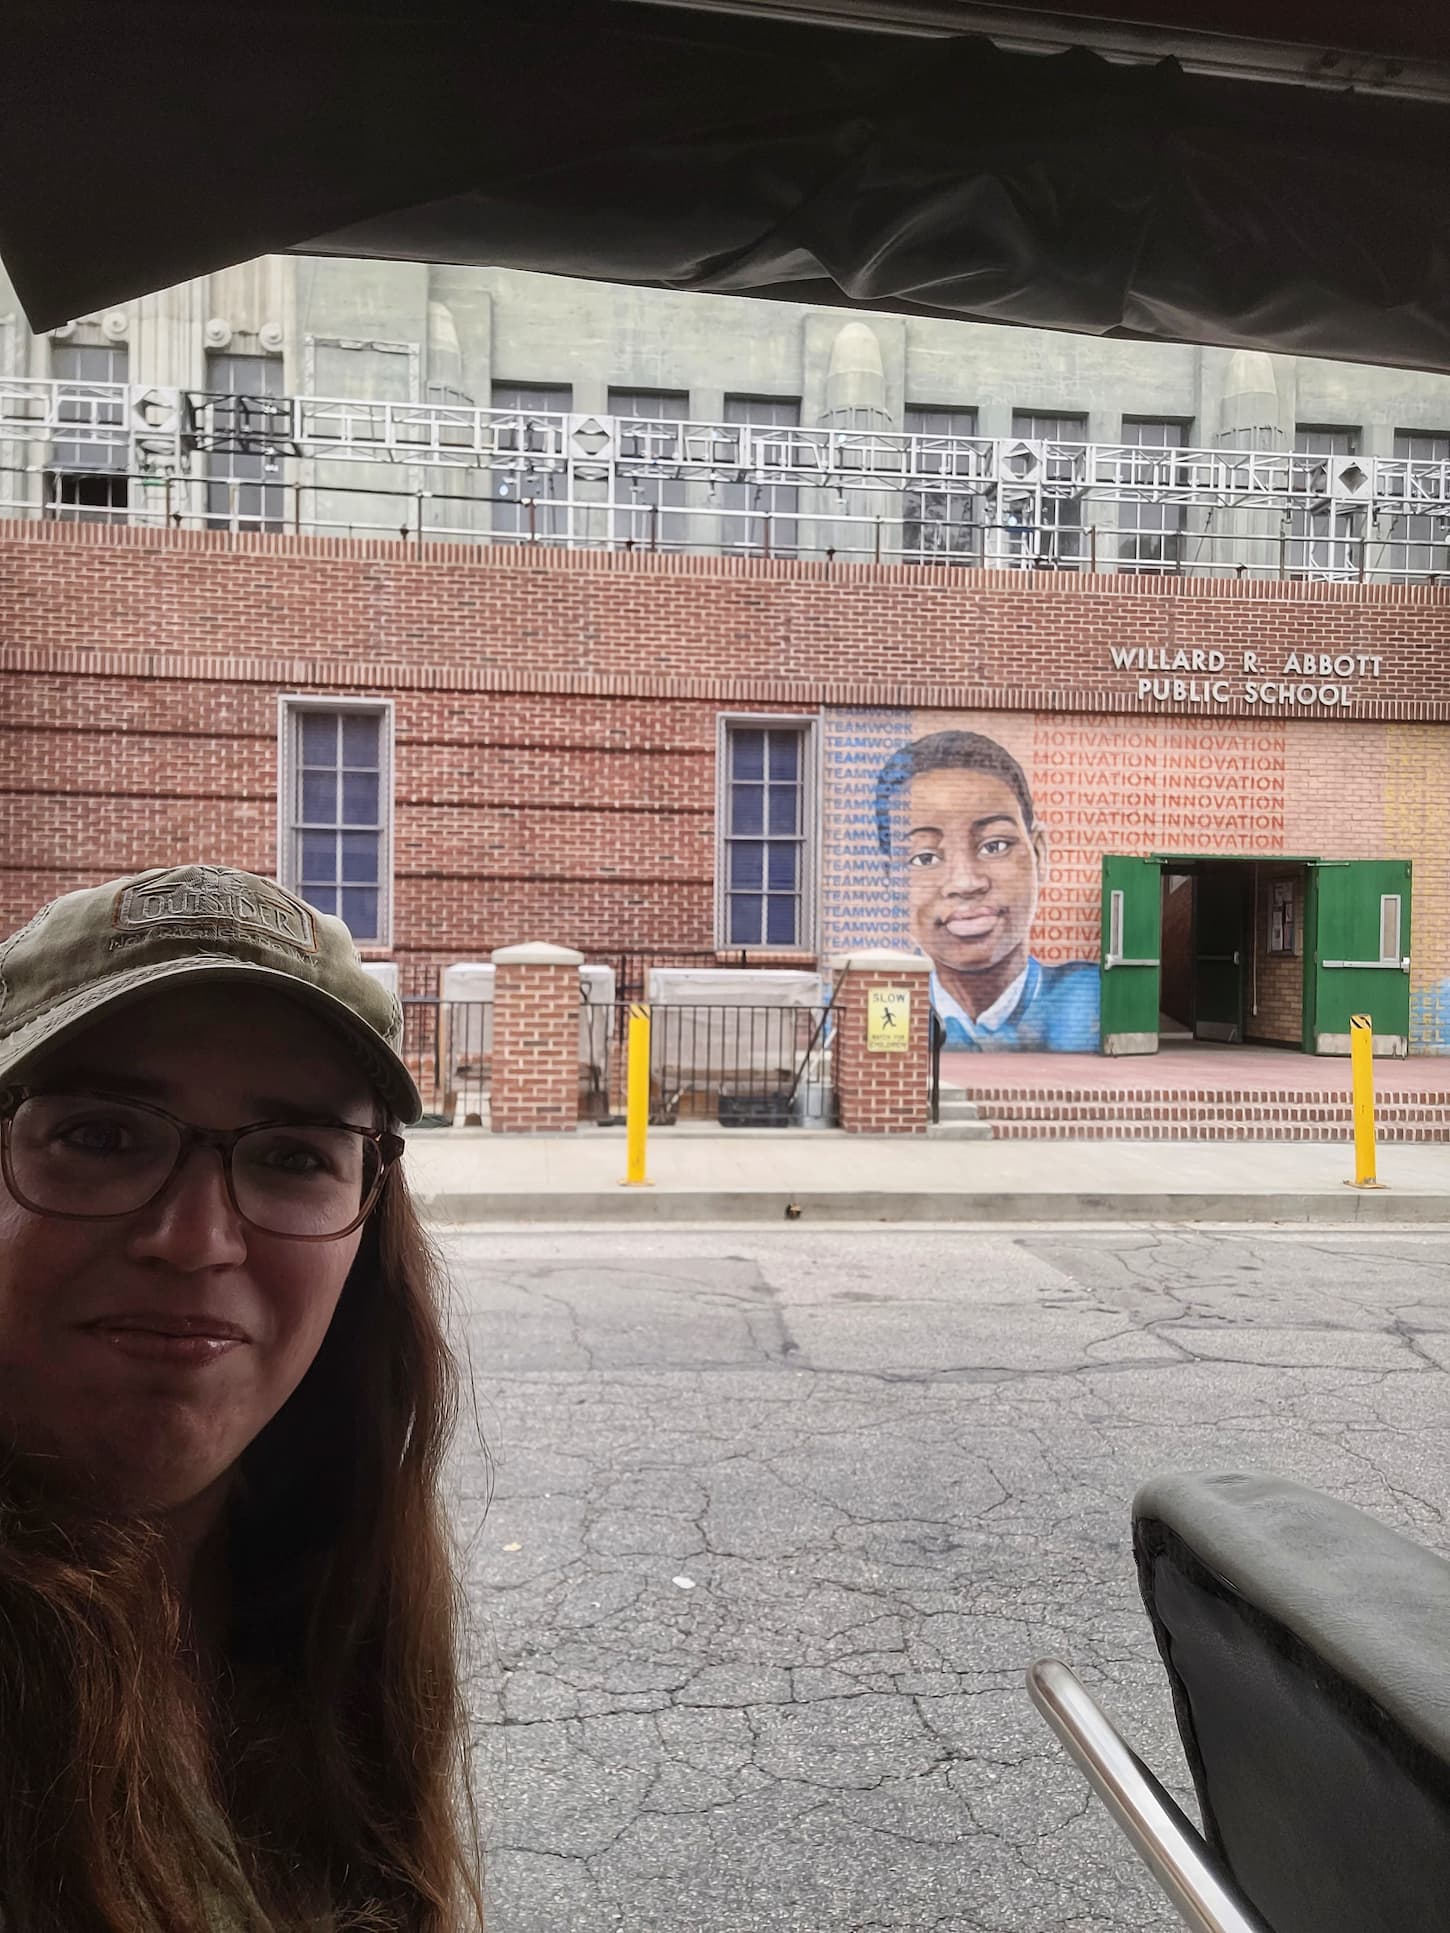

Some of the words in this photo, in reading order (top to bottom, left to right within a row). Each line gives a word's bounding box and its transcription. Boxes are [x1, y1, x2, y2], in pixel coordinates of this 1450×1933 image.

[1110, 646, 1225, 672] WILLARD
[1243, 651, 1265, 673] R.
[1283, 652, 1383, 677] ABBOTT
[1138, 678, 1230, 703] PUBLIC
[1244, 682, 1352, 706] SCHOOL
[825, 721, 912, 734] TEAMWORK
[1034, 714, 1157, 728] MOTIVATION
[1164, 718, 1287, 732] INNOVATION
[1033, 731, 1157, 748] MOTIVATION
[1164, 735, 1286, 752] INNOVATION
[1033, 751, 1157, 768] MOTIVATION
[1163, 754, 1285, 771] INNOVATION
[1033, 771, 1156, 788] MOTIVATION
[1163, 775, 1285, 792] INNOVATION
[1033, 791, 1156, 807] MOTIVATION
[1163, 794, 1284, 811] INNOVATION
[1034, 810, 1155, 826] MOTIVATION
[1162, 813, 1284, 830] INNOVATION
[1049, 830, 1155, 847] OTIVATION
[1162, 833, 1284, 849] INNOVATION
[823, 875, 911, 887] TEAMWORK
[823, 891, 910, 902] TEAMWORK
[142, 891, 297, 938] OUTSIDER
[823, 906, 910, 918] TEAMWORK
[823, 921, 910, 933] TEAMWORK
[823, 936, 911, 949] TEAMWORK
[873, 993, 905, 1003] SLOW
